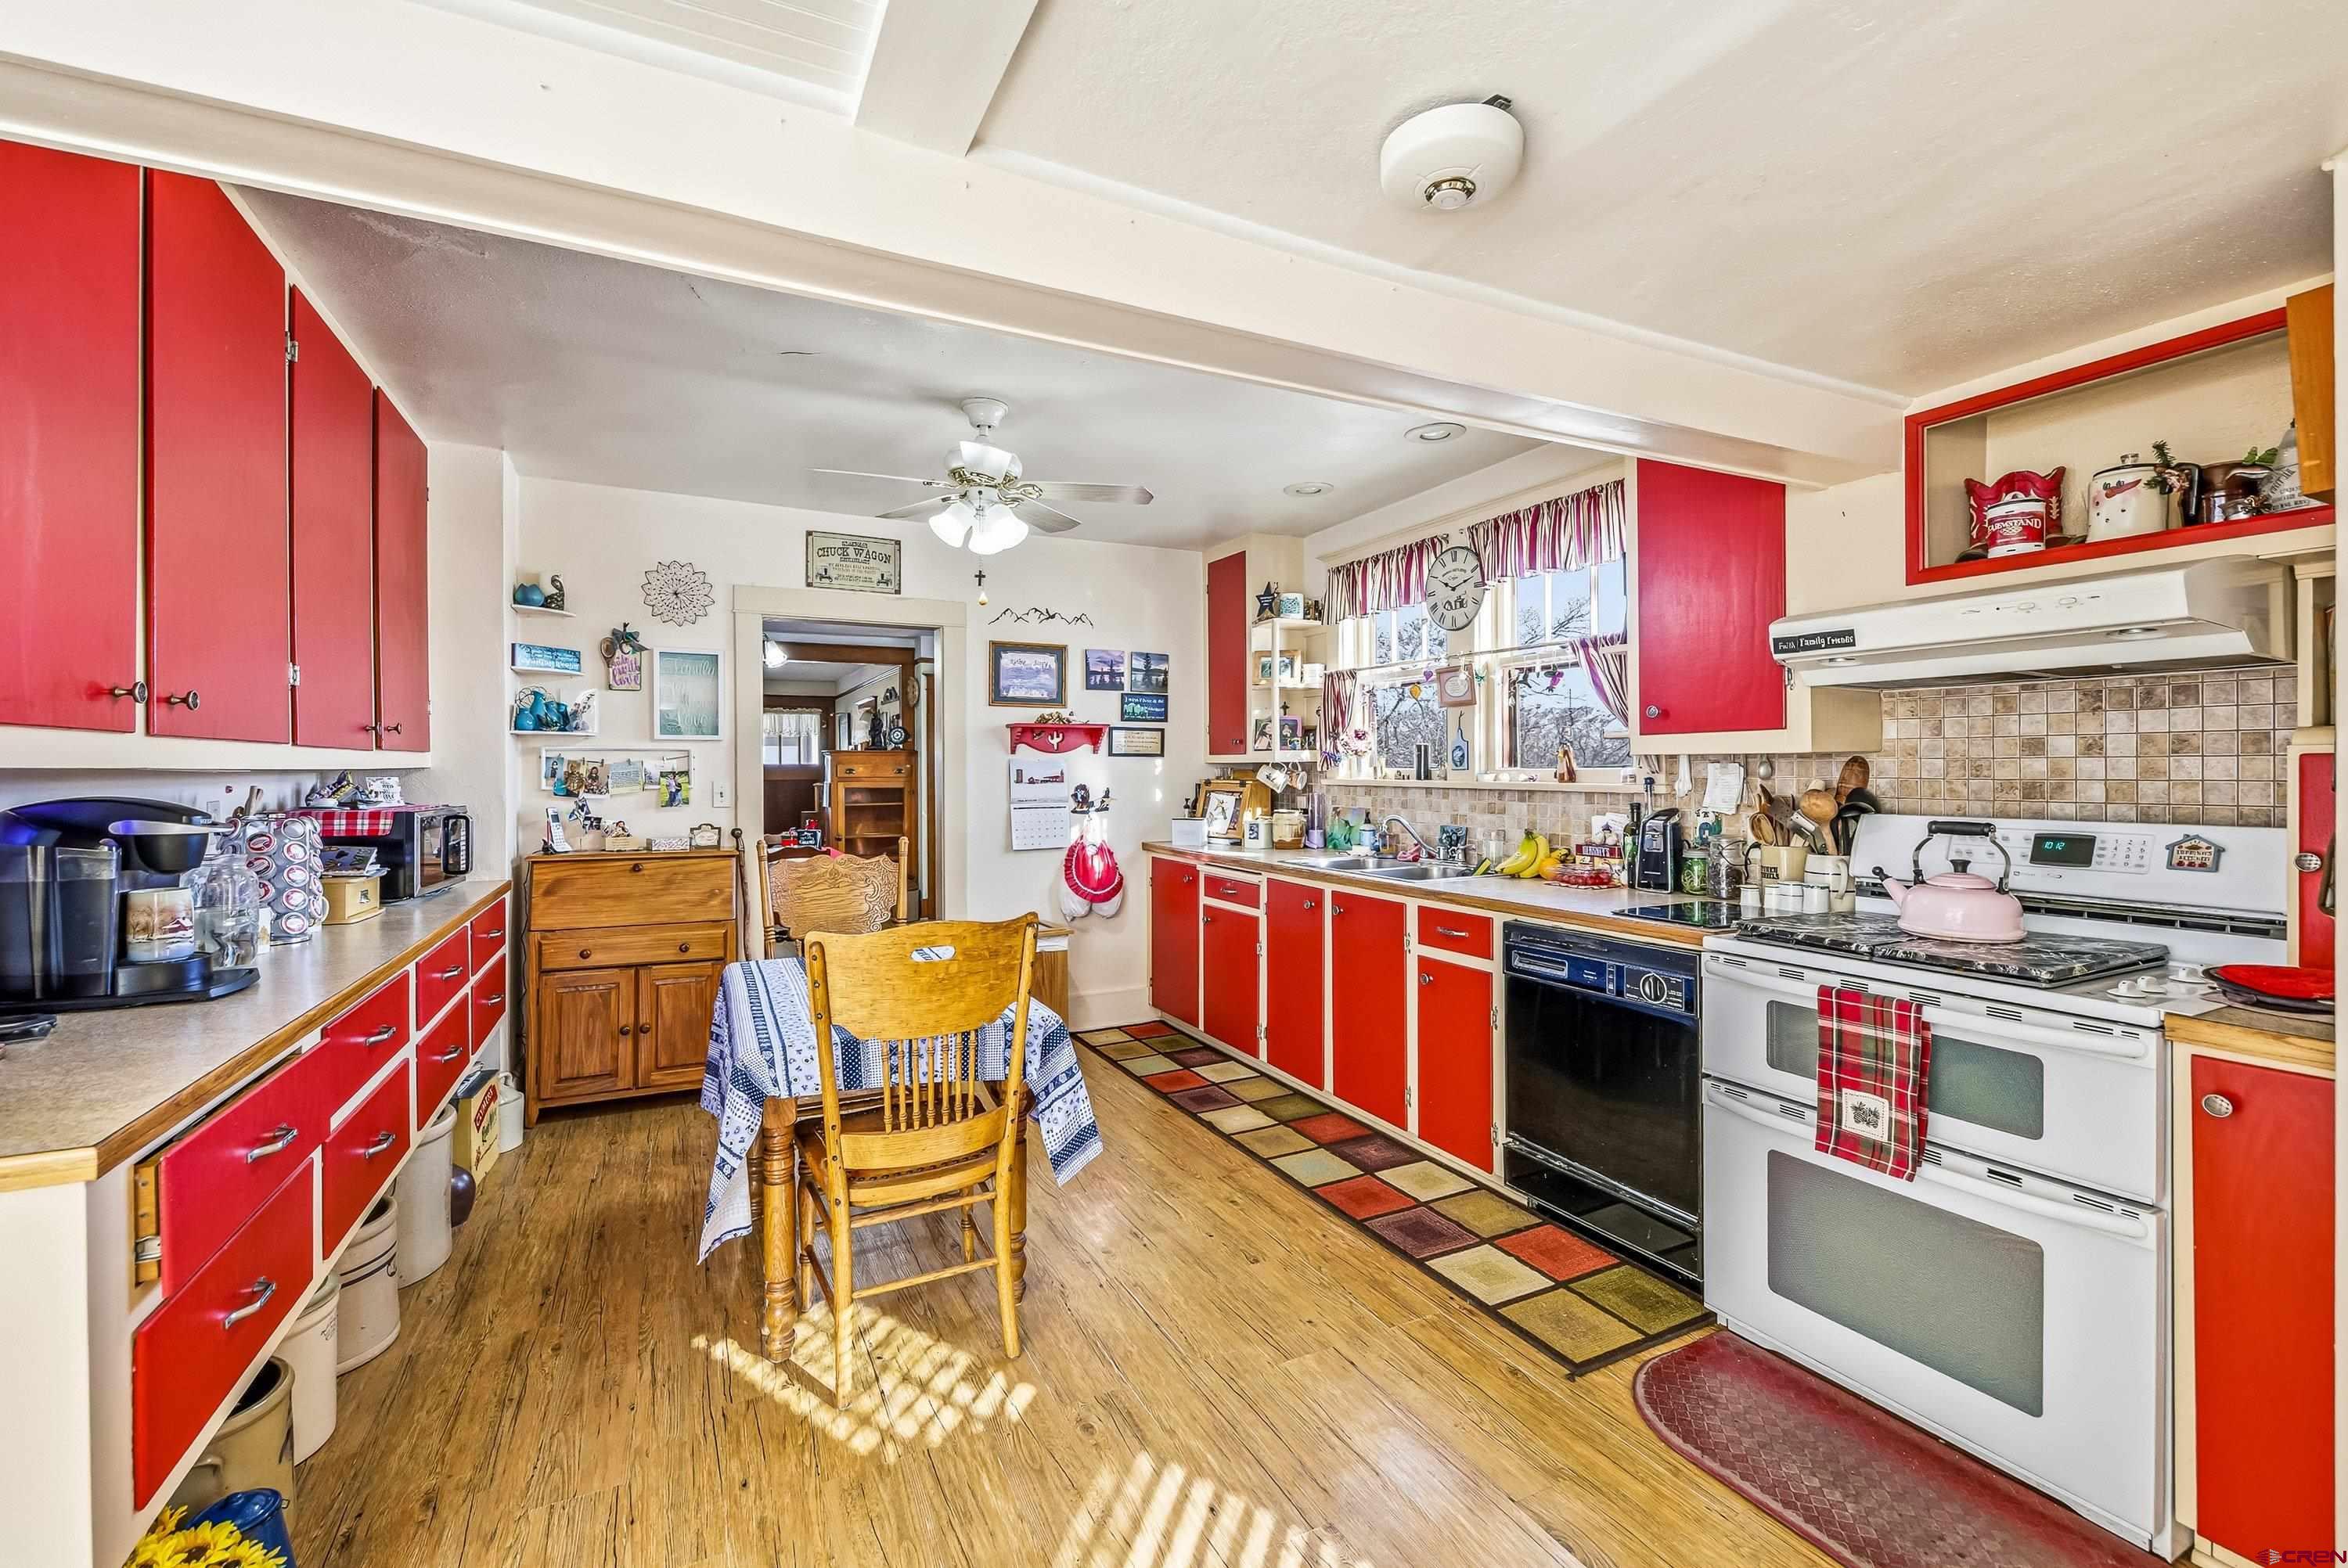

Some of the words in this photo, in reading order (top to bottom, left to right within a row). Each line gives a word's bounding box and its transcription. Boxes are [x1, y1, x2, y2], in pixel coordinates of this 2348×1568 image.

[816, 547, 850, 558] CHUCK
[853, 548, 891, 563] WAGON
[1799, 636, 1826, 648] Family
[1827, 635, 1853, 645] Friends
